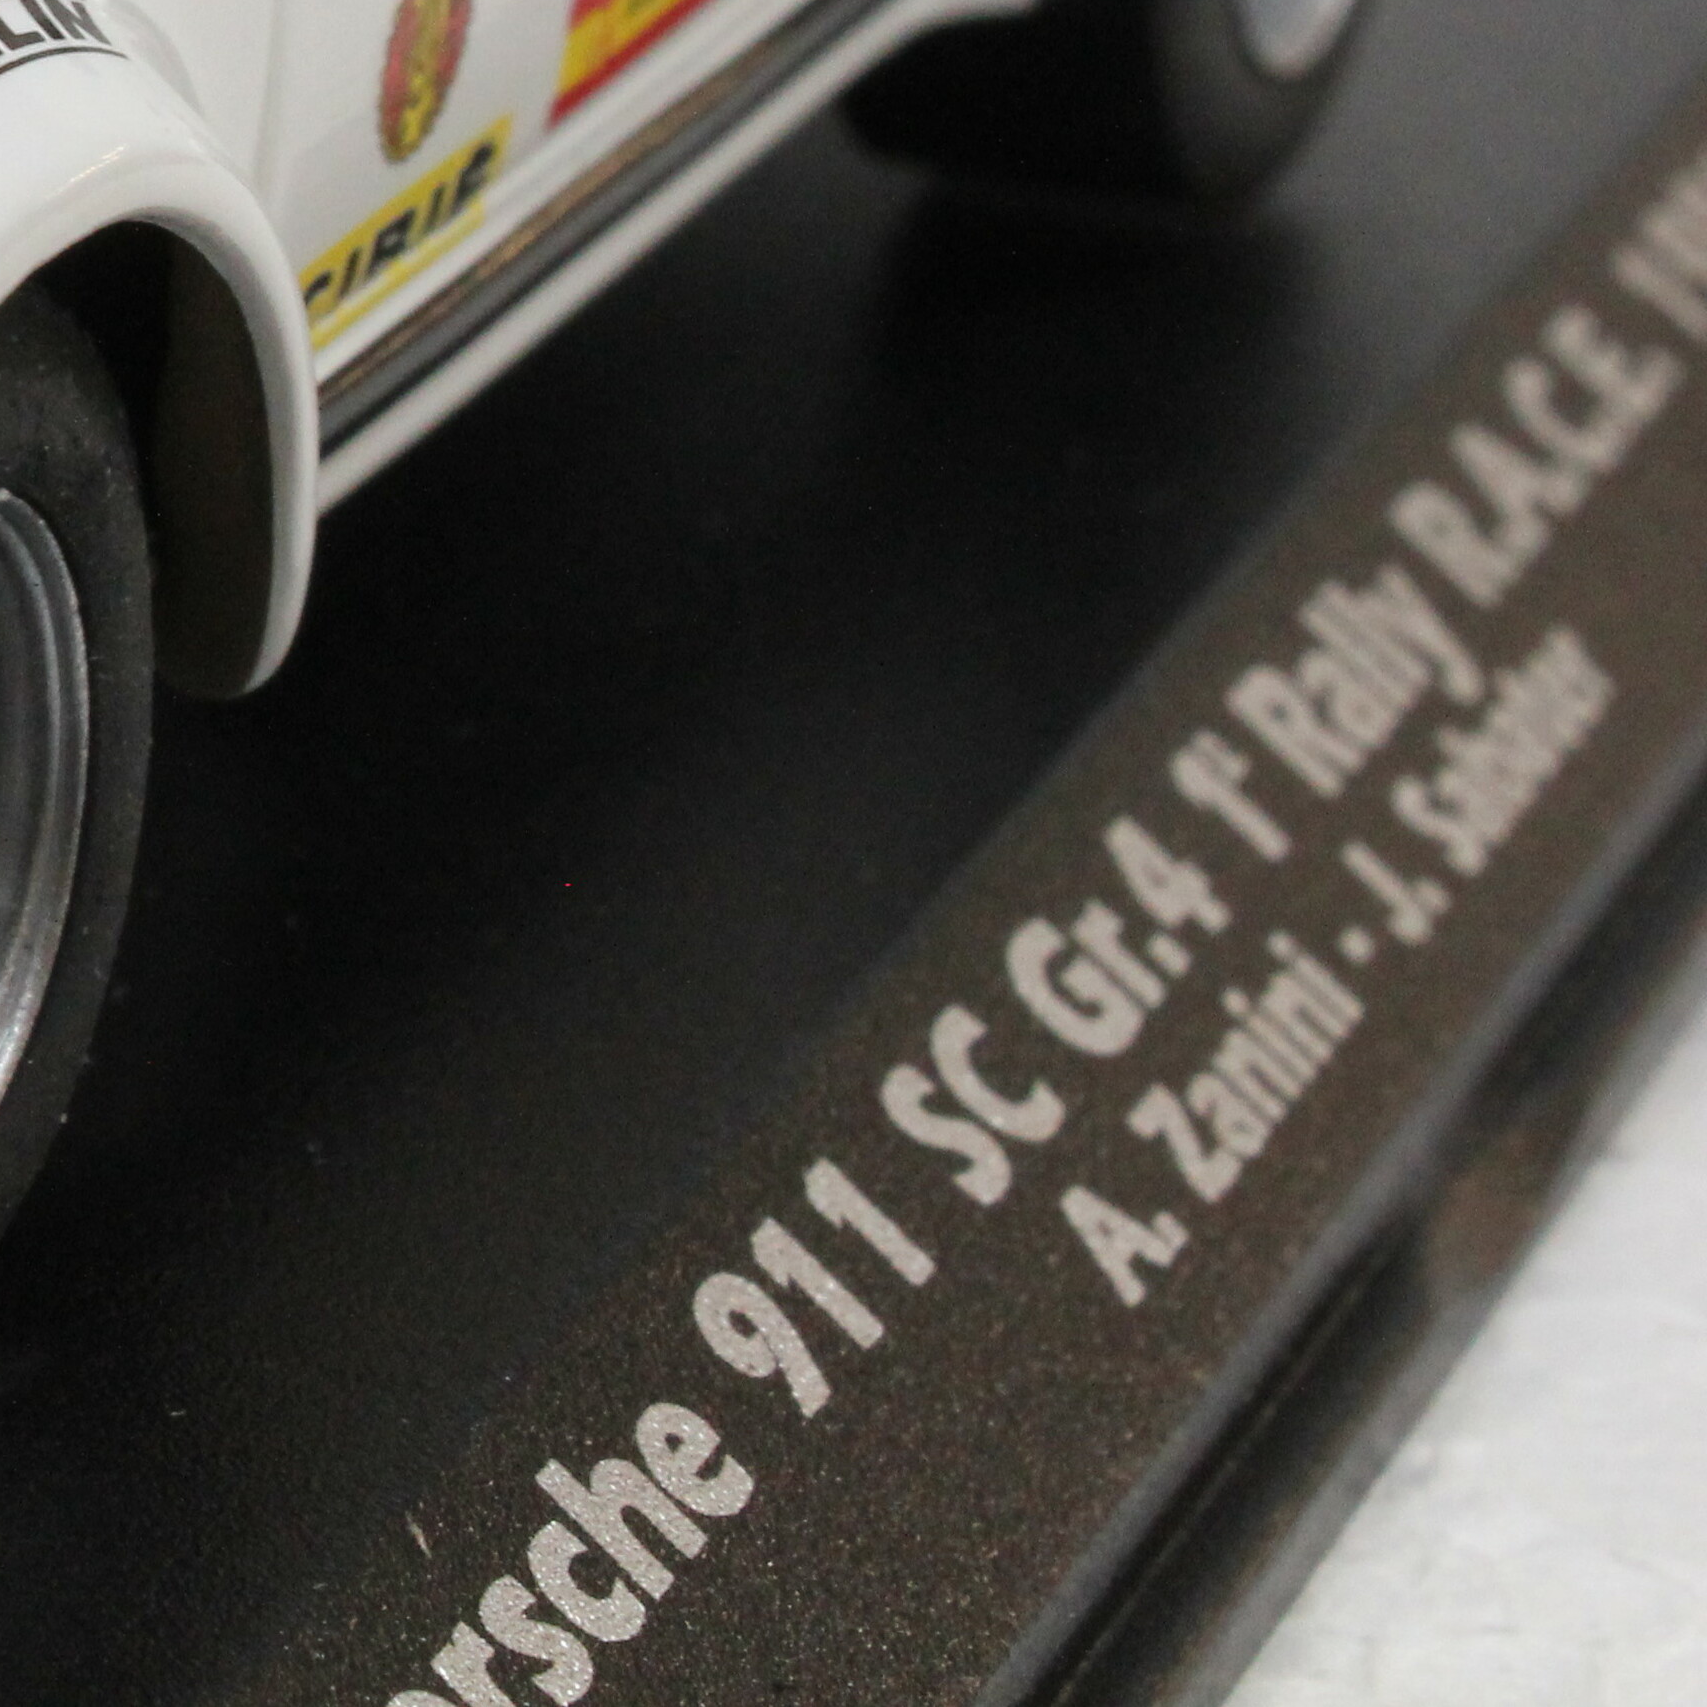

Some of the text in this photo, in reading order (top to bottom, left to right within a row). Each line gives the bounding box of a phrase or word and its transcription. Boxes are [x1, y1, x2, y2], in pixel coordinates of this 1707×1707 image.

[387, 1401, 755, 1707] rsche
[691, 1156, 938, 1420] 911
[880, 1003, 1067, 1207] SC
[1003, 814, 1232, 1057] Gr.4
[1226, 563, 1483, 800] Rally
[1124, 930, 1366, 1203] Zanini
[1059, 1183, 1190, 1306] A.
